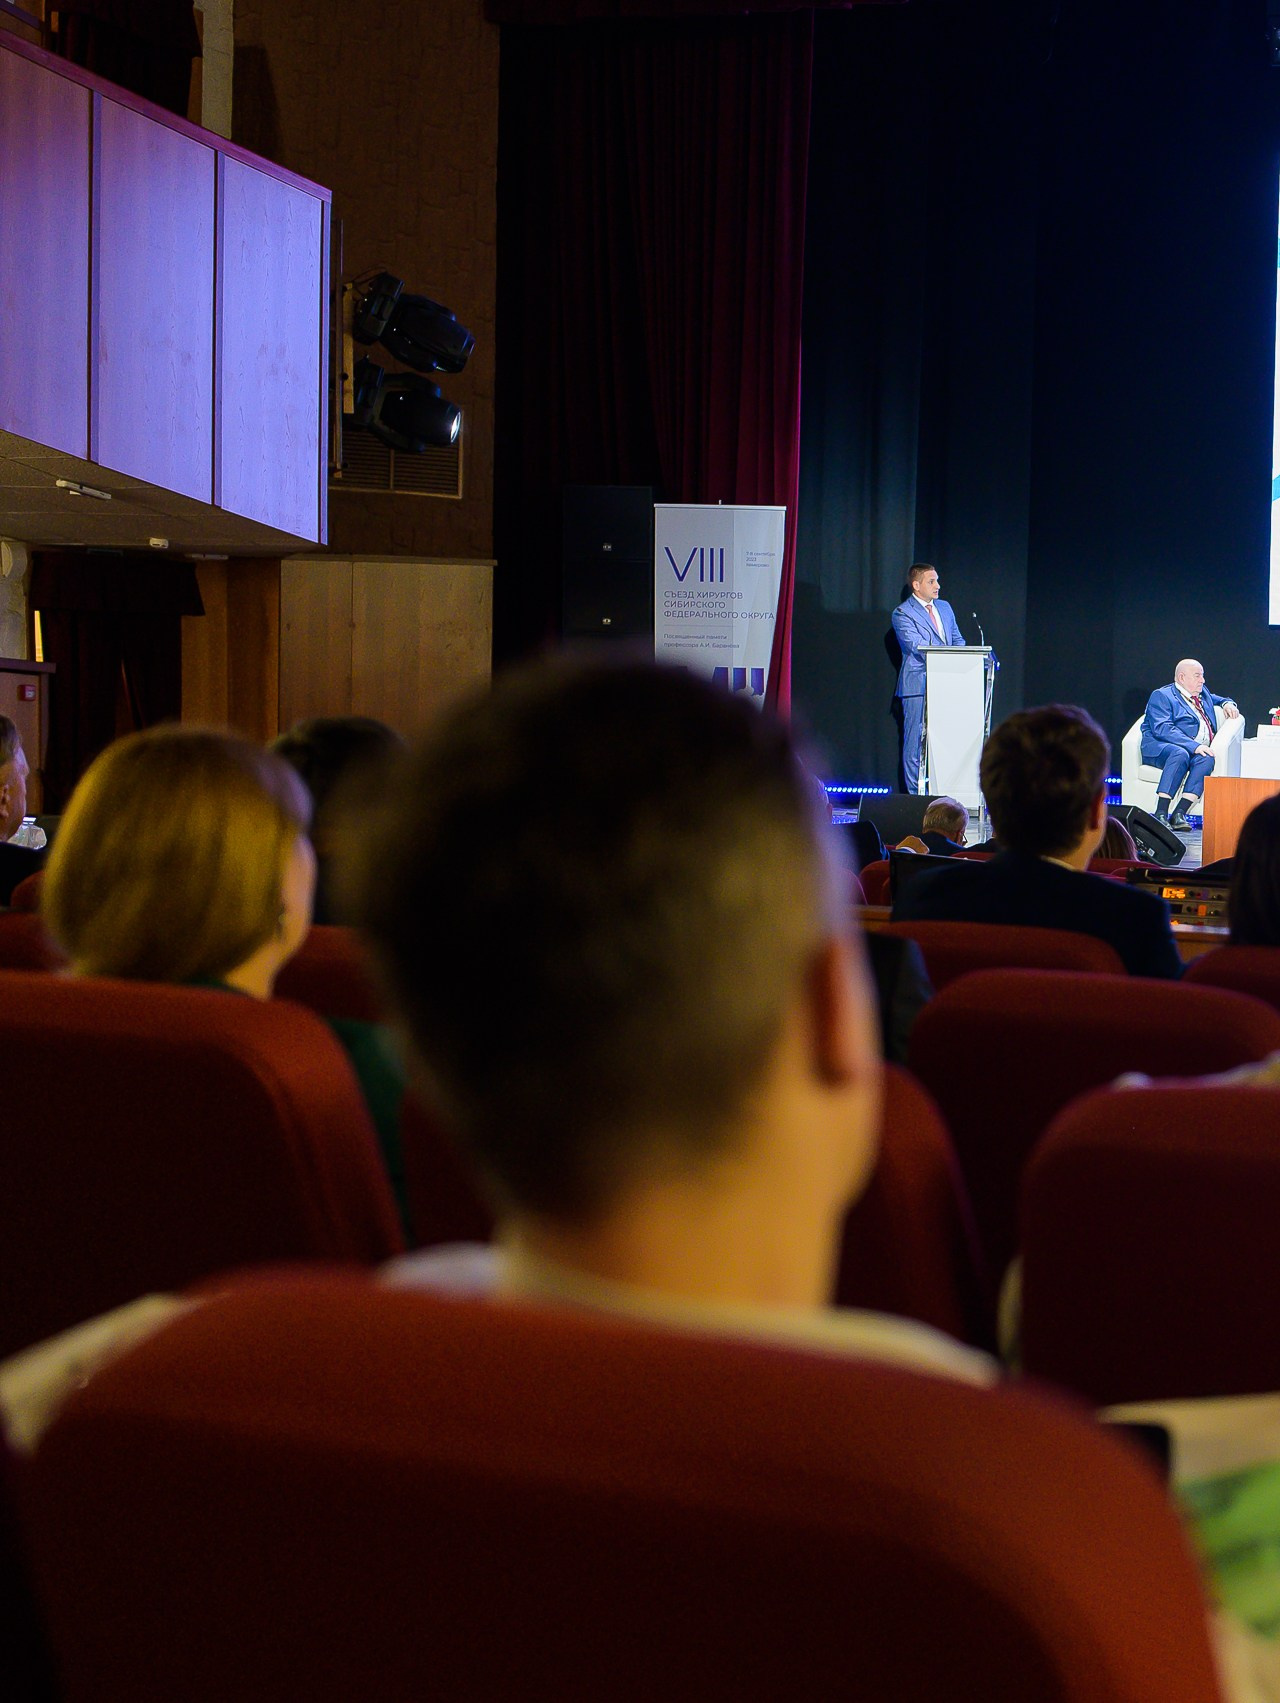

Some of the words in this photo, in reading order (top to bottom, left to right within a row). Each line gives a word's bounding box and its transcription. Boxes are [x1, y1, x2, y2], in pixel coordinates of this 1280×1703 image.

[664, 546, 724, 583] VIII
[664, 590, 695, 600] СЪЕЗД
[696, 591, 743, 600] ХИРУРГОВ
[664, 600, 726, 609] СИБИРСКОГО
[663, 609, 739, 619] ФЕДЕРАЛЬНОГО
[741, 611, 775, 620] ОКРУГА
